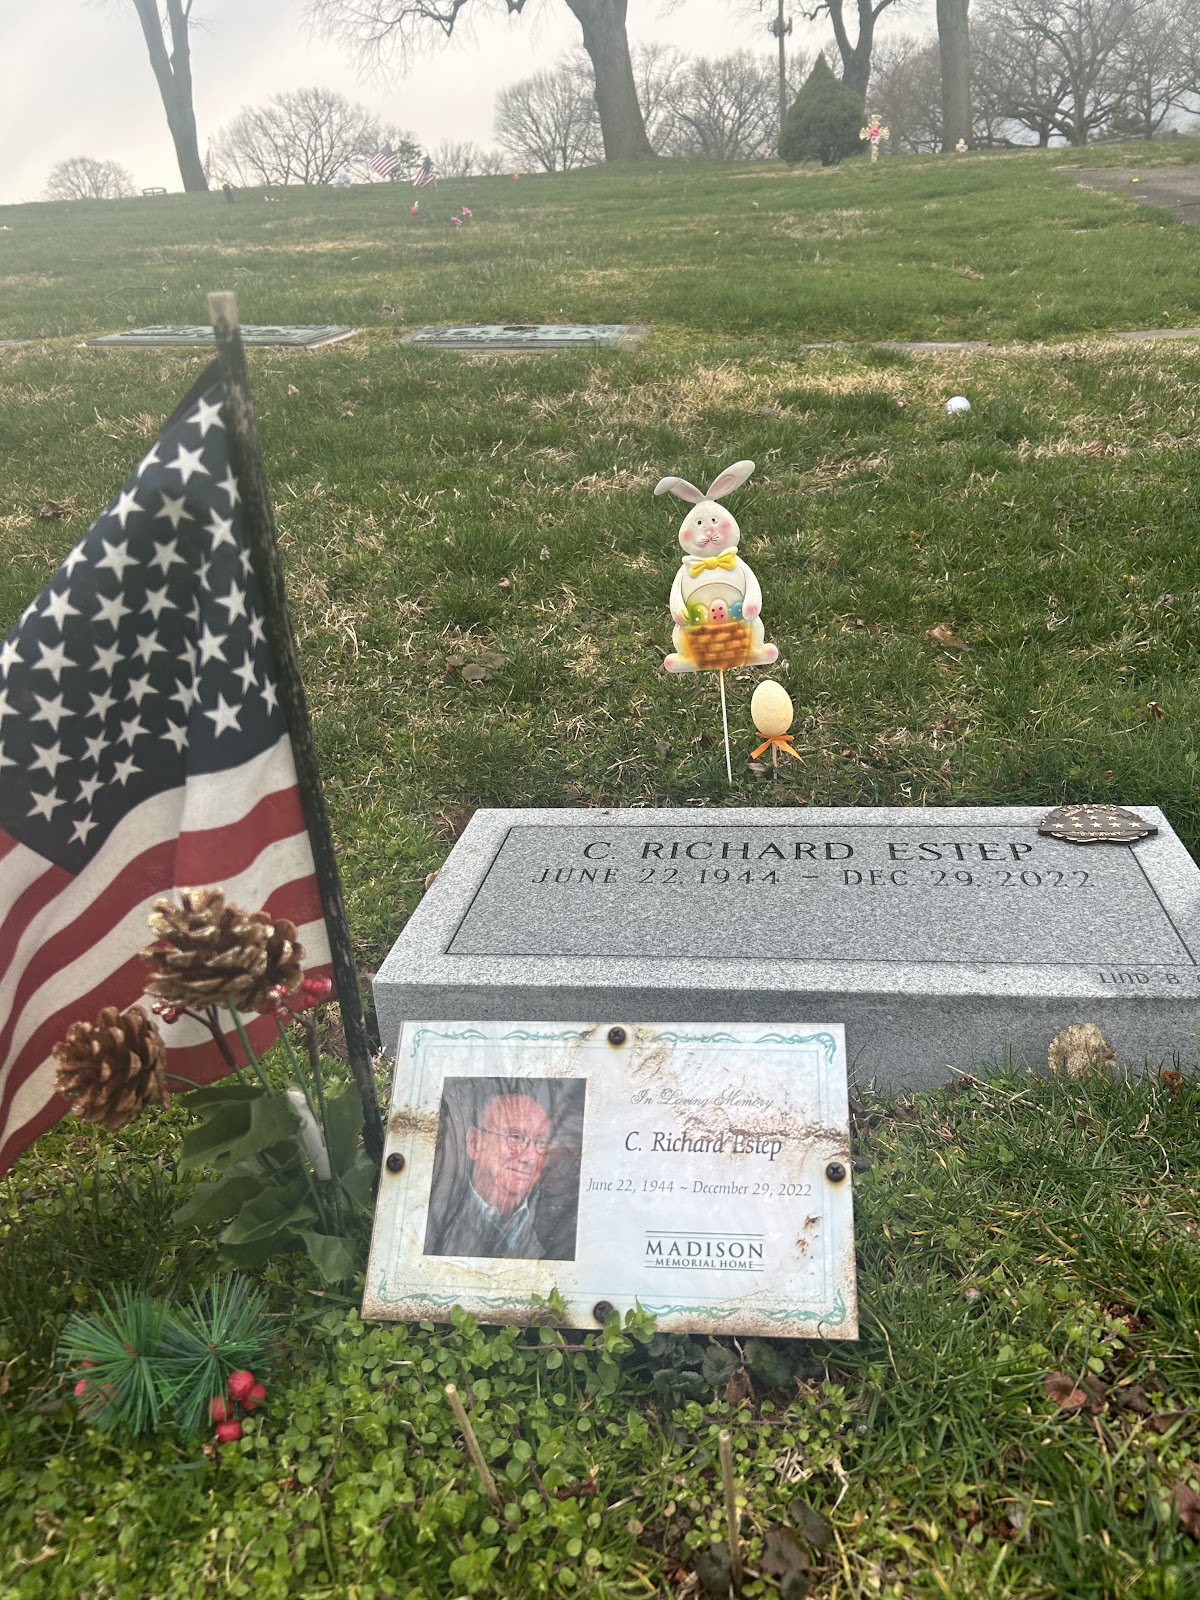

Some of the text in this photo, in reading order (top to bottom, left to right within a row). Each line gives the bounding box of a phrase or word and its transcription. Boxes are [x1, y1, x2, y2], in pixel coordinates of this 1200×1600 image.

[583, 841, 1033, 861] C. RICHARD ESTEP
[532, 868, 619, 884] JUNE
[699, 869, 780, 885] 1944
[996, 870, 1095, 887] 2022
[630, 1087, 775, 1113] In Loving Memory
[625, 1131, 782, 1161] C. Richard Estep
[586, 1177, 613, 1192] June
[616, 1179, 636, 1194] 22,
[642, 1180, 674, 1193] 1944
[692, 1180, 749, 1195] December
[752, 1182, 773, 1198] 29,
[778, 1184, 812, 1197] 2022
[645, 1240, 764, 1259] MADISON
[655, 1258, 754, 1269] MEMORIAL HOME
